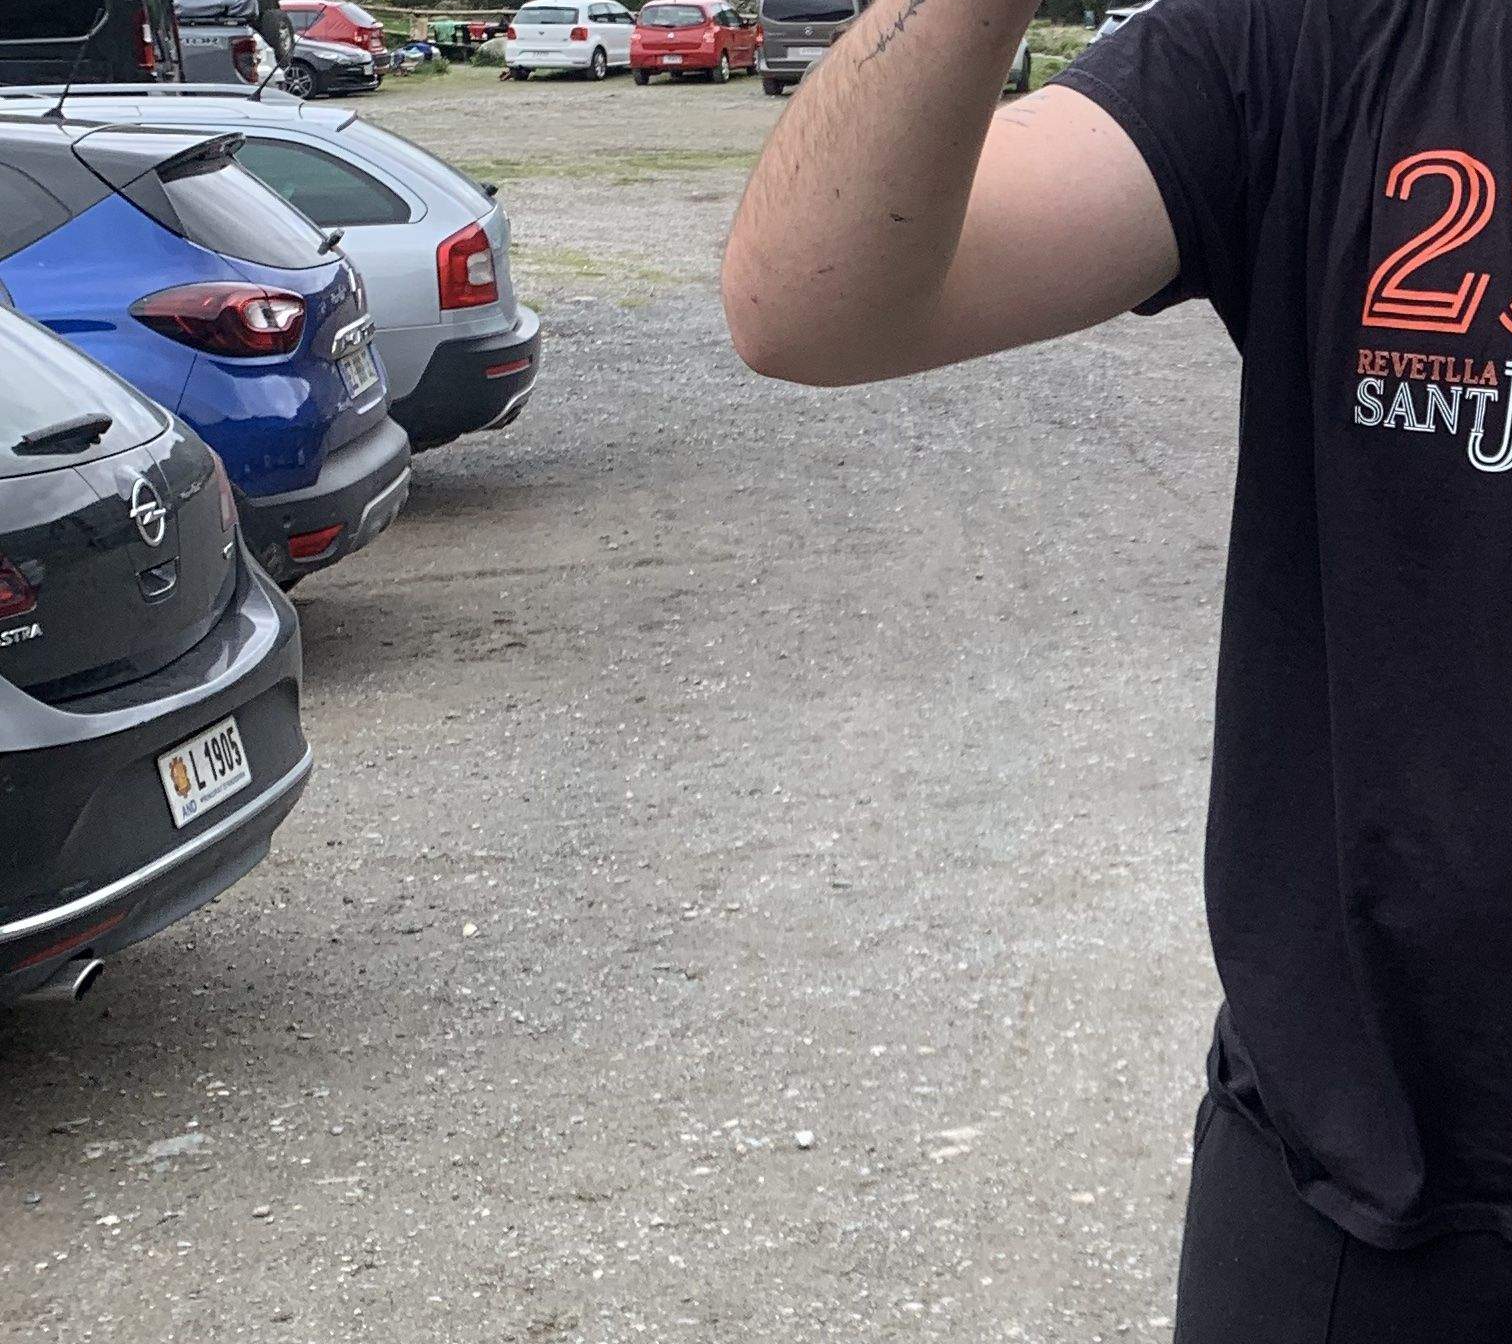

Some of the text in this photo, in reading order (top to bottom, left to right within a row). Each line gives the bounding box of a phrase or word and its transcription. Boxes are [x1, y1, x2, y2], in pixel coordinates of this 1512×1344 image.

[1356, 348, 1499, 386] REVETLLA
[1354, 377, 1499, 435] SANT
[0, 623, 43, 646] STRA
[204, 725, 242, 782] 1905
